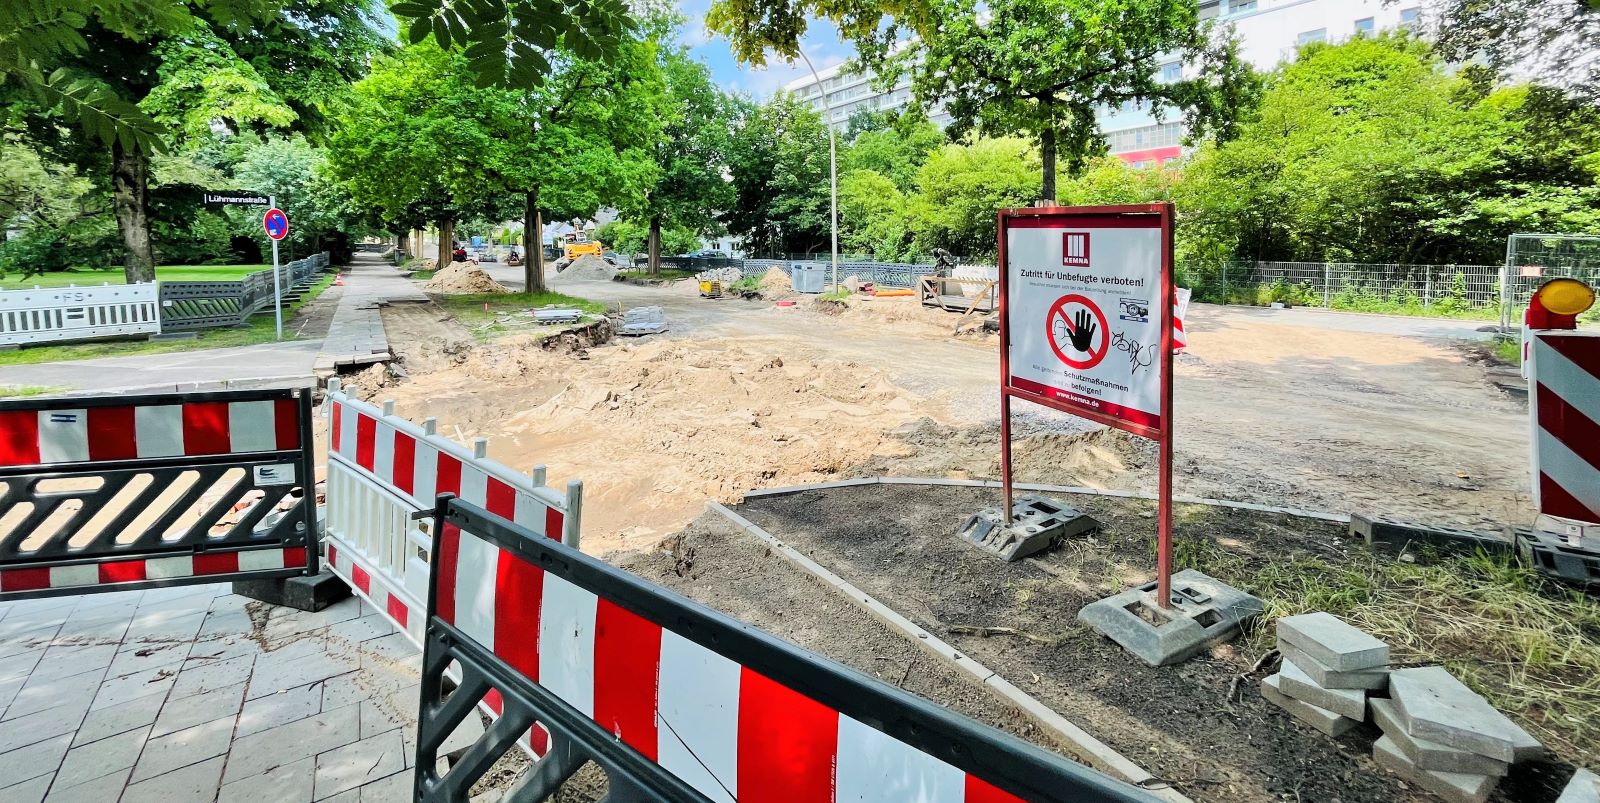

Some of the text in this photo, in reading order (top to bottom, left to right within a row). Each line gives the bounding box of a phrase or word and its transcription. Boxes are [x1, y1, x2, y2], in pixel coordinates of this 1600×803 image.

[208, 195, 267, 204] Lühmannstraße
[1020, 269, 1144, 287] Zutritt für Unbefugte verboten!
[1063, 371, 1129, 392] Schutzmaßnahmen
[1071, 383, 1102, 396] befolgen!
[1055, 391, 1099, 408] www.kemna.de
